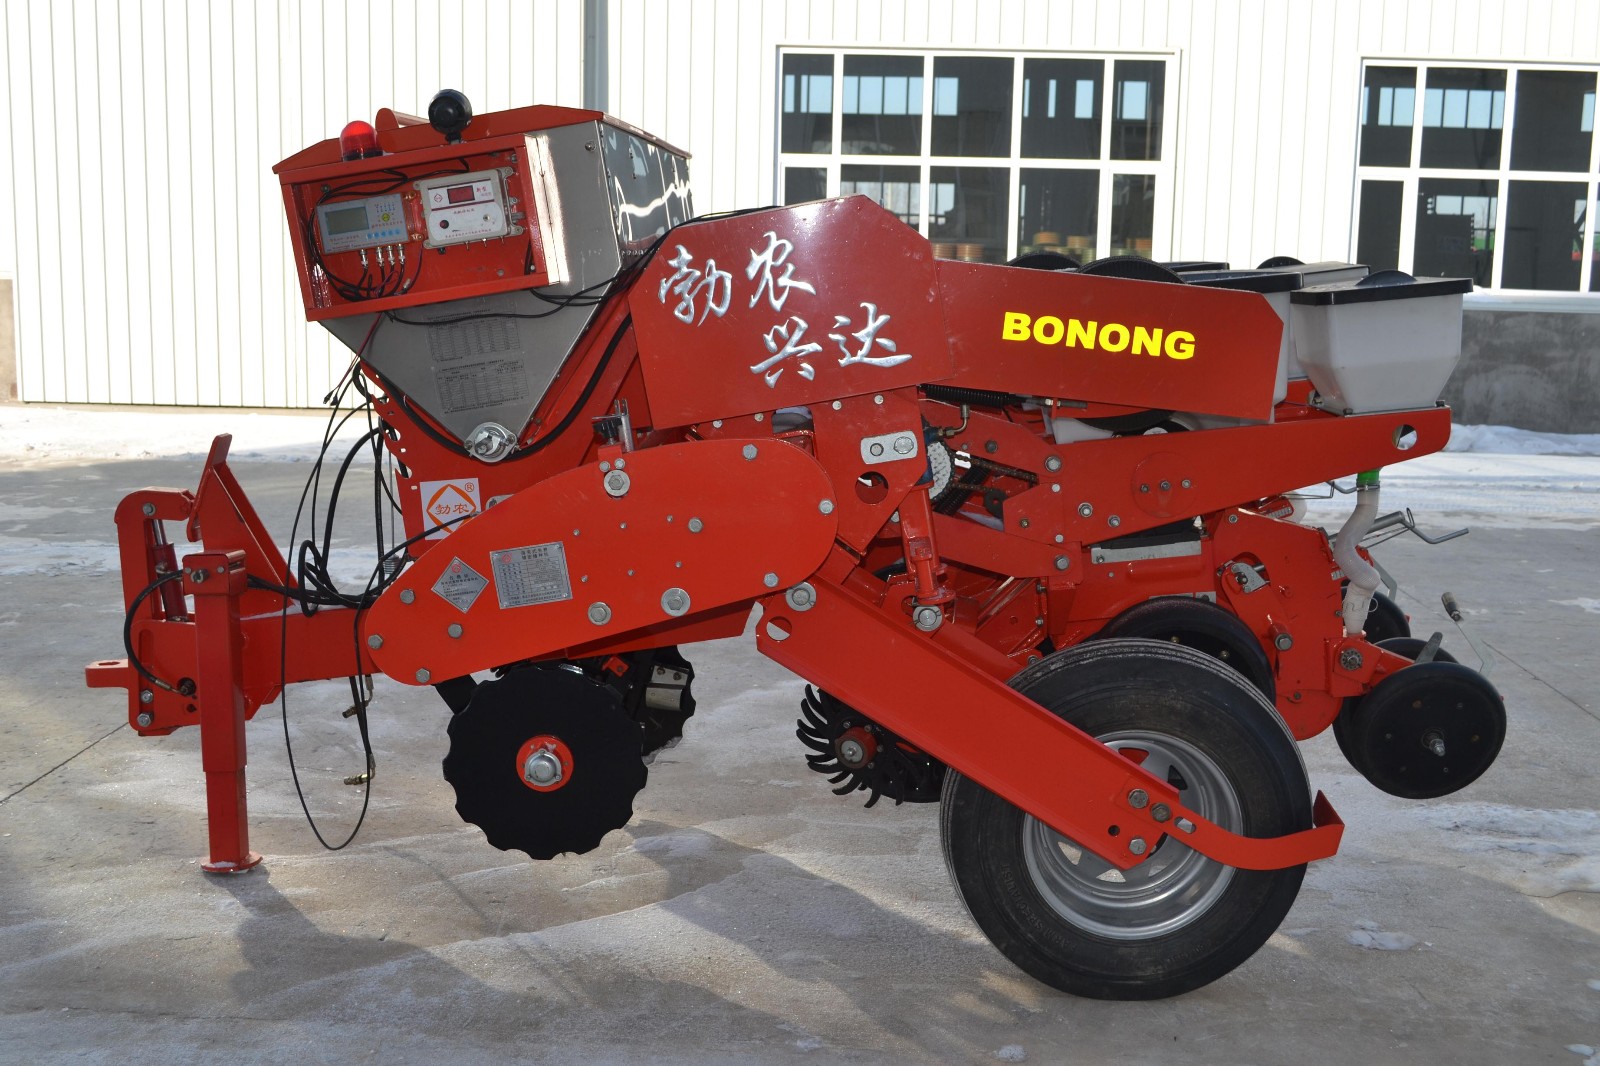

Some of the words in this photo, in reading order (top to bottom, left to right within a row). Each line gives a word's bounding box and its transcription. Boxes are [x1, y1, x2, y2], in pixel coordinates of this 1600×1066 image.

[658, 231, 816, 326] 勃农
[750, 302, 912, 388] 兴达
[1002, 312, 1195, 360] BONONG
[435, 503, 469, 515] 勃农
